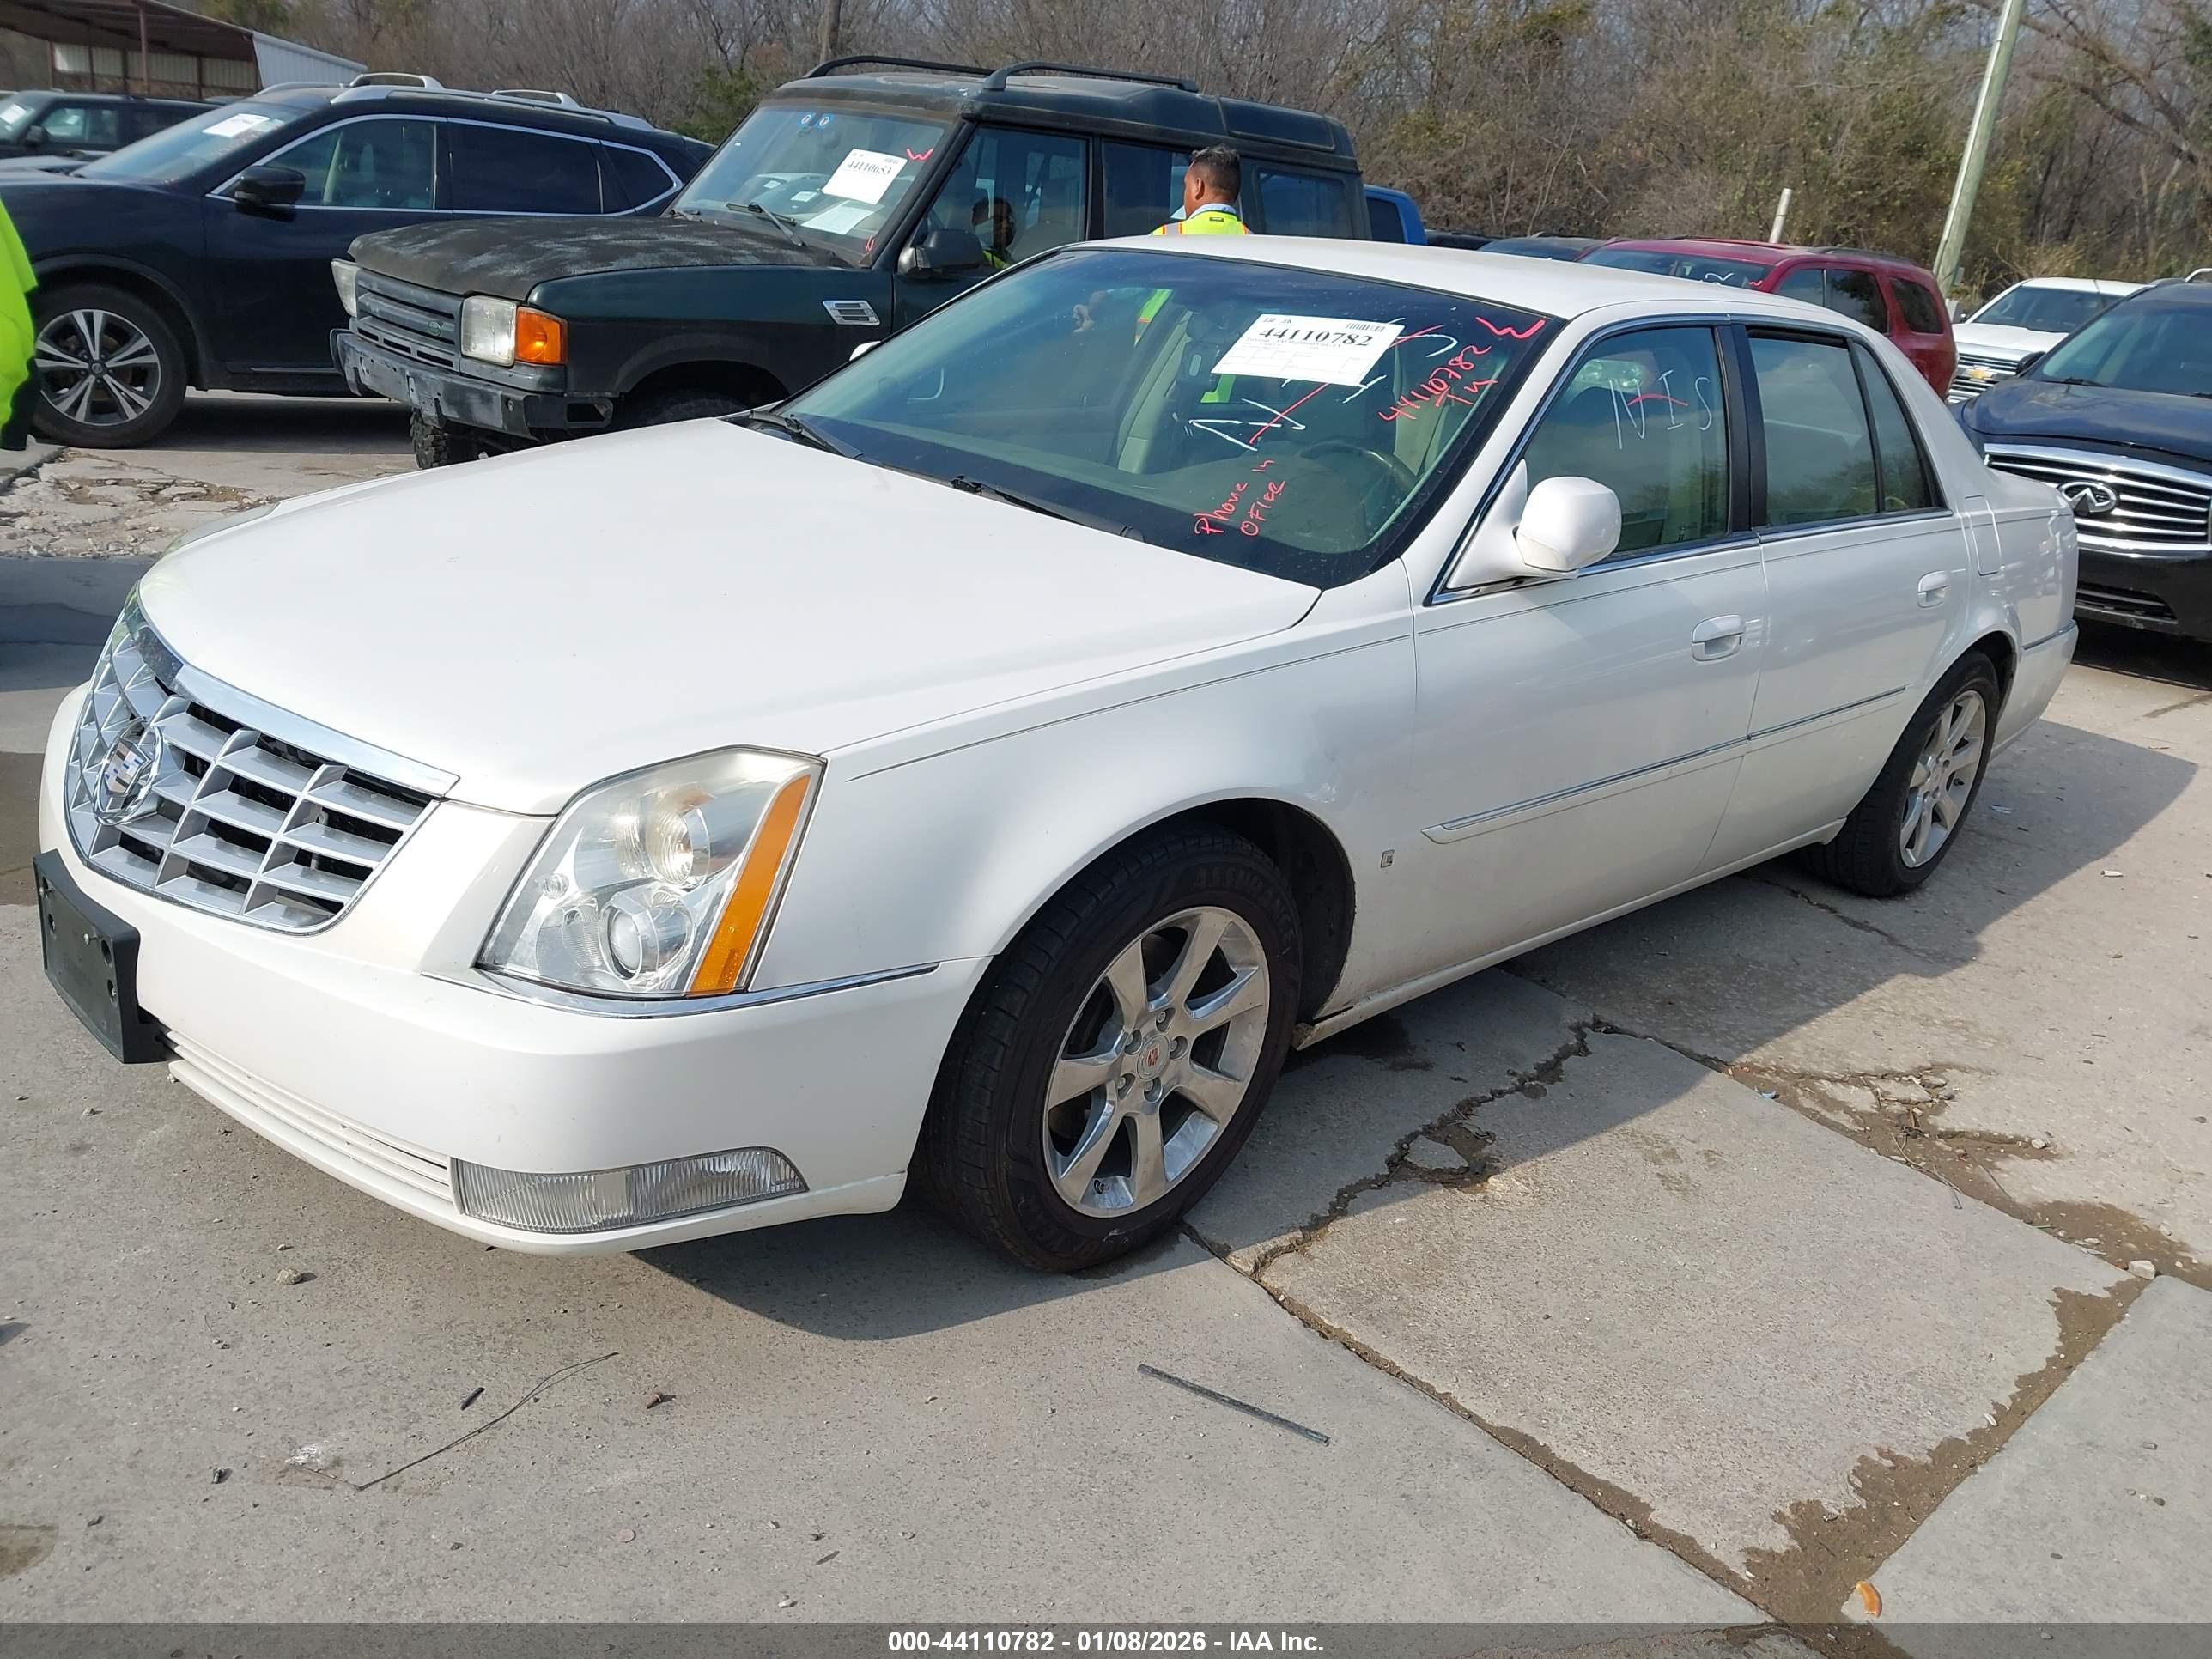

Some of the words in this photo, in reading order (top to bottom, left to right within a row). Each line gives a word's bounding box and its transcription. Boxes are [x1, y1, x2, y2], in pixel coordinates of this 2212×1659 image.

[847, 161, 892, 176] 44110653
[1259, 326, 1374, 347] 44110782
[1608, 369, 1712, 450] NIS
[1193, 482, 1249, 535] Phone
